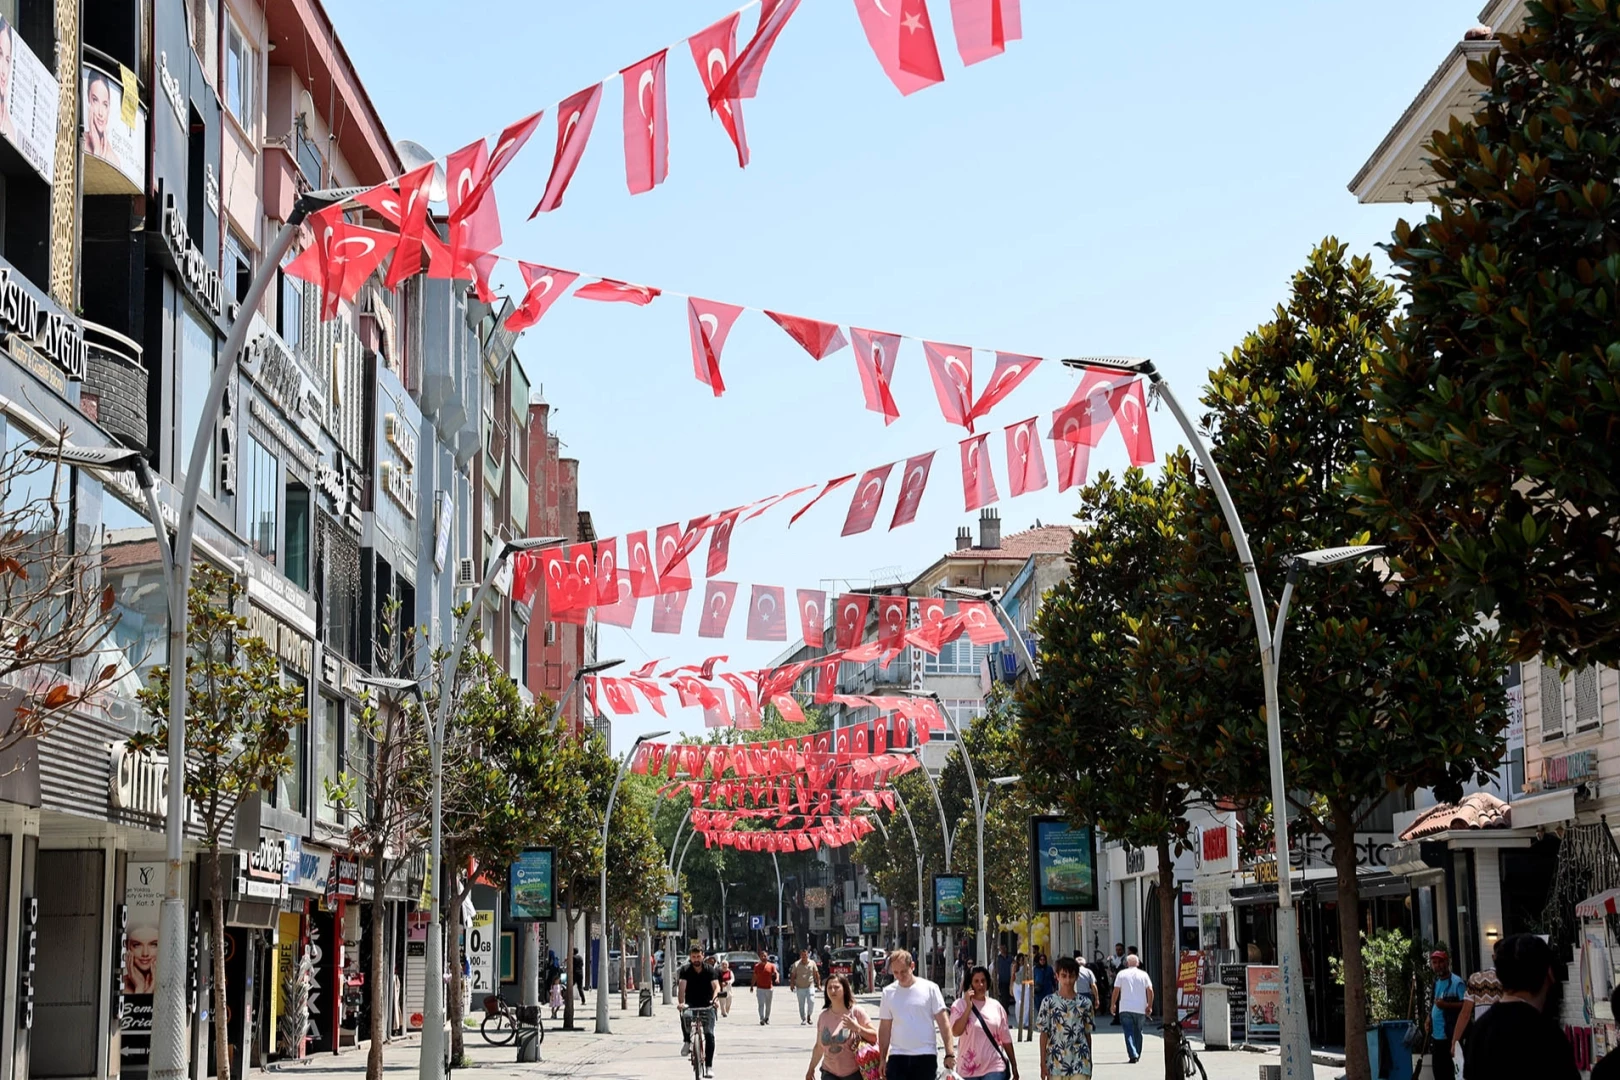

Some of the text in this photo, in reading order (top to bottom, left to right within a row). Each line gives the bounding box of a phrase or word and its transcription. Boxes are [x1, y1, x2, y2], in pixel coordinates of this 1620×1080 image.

[752, 917, 760, 928] P
[481, 941, 491, 952] GB
[481, 981, 488, 989] TL
